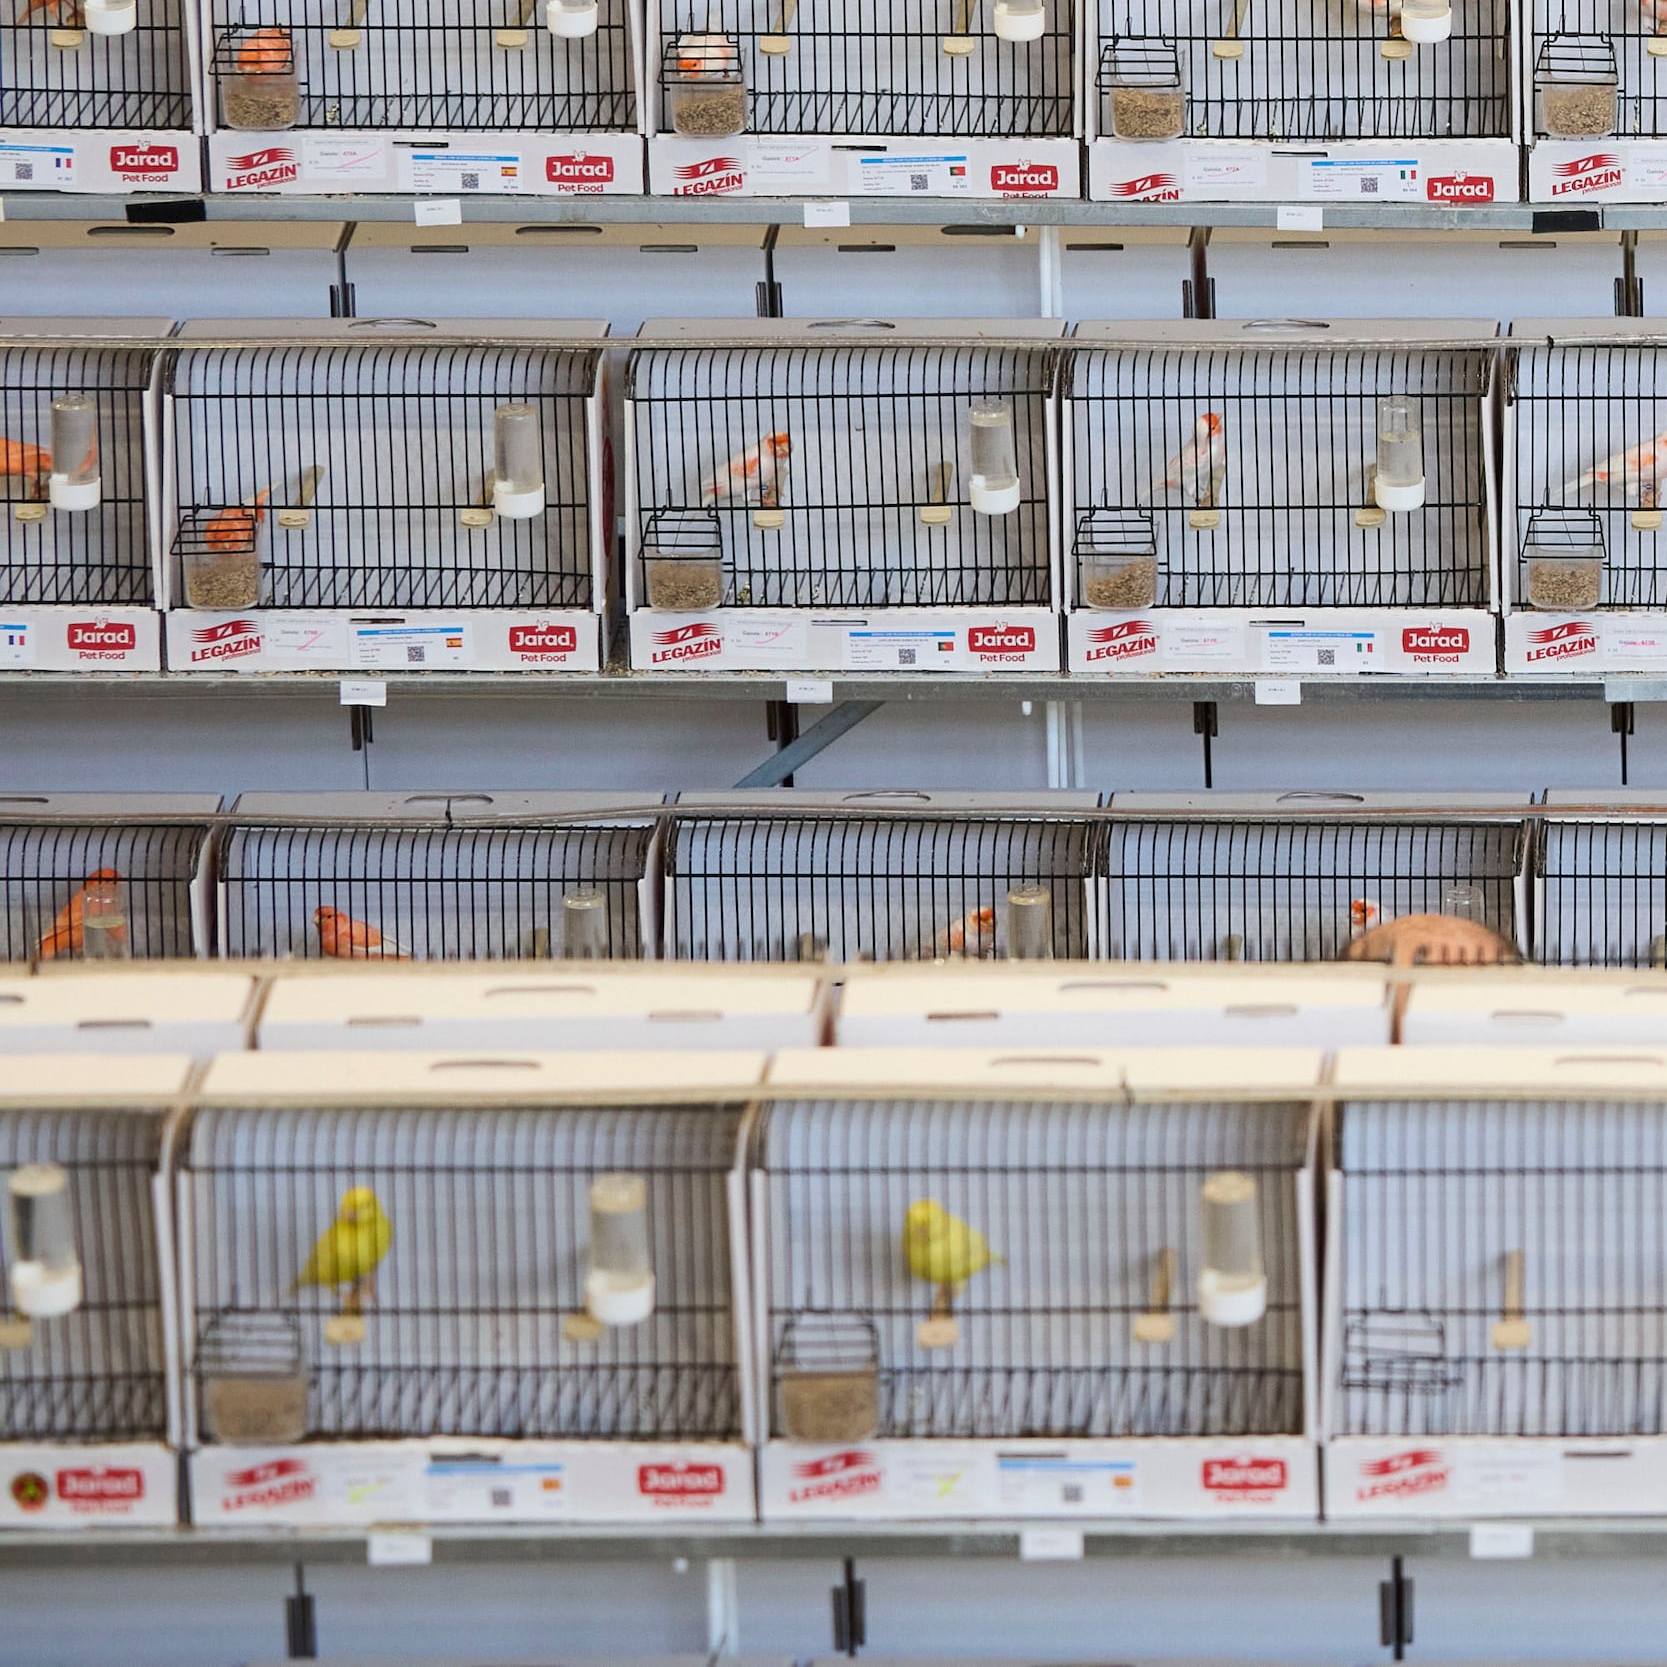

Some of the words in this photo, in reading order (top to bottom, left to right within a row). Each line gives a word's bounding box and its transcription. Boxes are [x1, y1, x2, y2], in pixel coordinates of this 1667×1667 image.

[116, 152, 172, 166] Jarad
[227, 162, 298, 190] LEGAZÍN
[552, 162, 608, 176] Jarad
[122, 174, 140, 182] Pet
[142, 174, 168, 182] Food
[996, 170, 1052, 185] Jarad
[1552, 168, 1623, 196] LEGAZÍN
[558, 184, 576, 192] Pet
[578, 184, 604, 192] Food
[1432, 182, 1488, 196] Jarad
[74, 628, 128, 643] Jarad
[516, 632, 570, 646] Jarad
[974, 632, 1028, 646] Jarad
[1408, 632, 1462, 647] Jarad
[191, 634, 262, 662] LEGAZÍN
[652, 636, 723, 664] LEGAZÍN
[1087, 634, 1158, 662] LEGAZÍN
[1527, 635, 1598, 662] LEGAZÍN
[80, 651, 97, 660] Pet
[99, 651, 124, 660] Food
[522, 654, 539, 662] Pet
[541, 654, 566, 662] Food
[980, 654, 997, 662] Pet
[999, 654, 1024, 662] Food
[1414, 655, 1431, 664] Pet
[1433, 655, 1458, 664] Food
